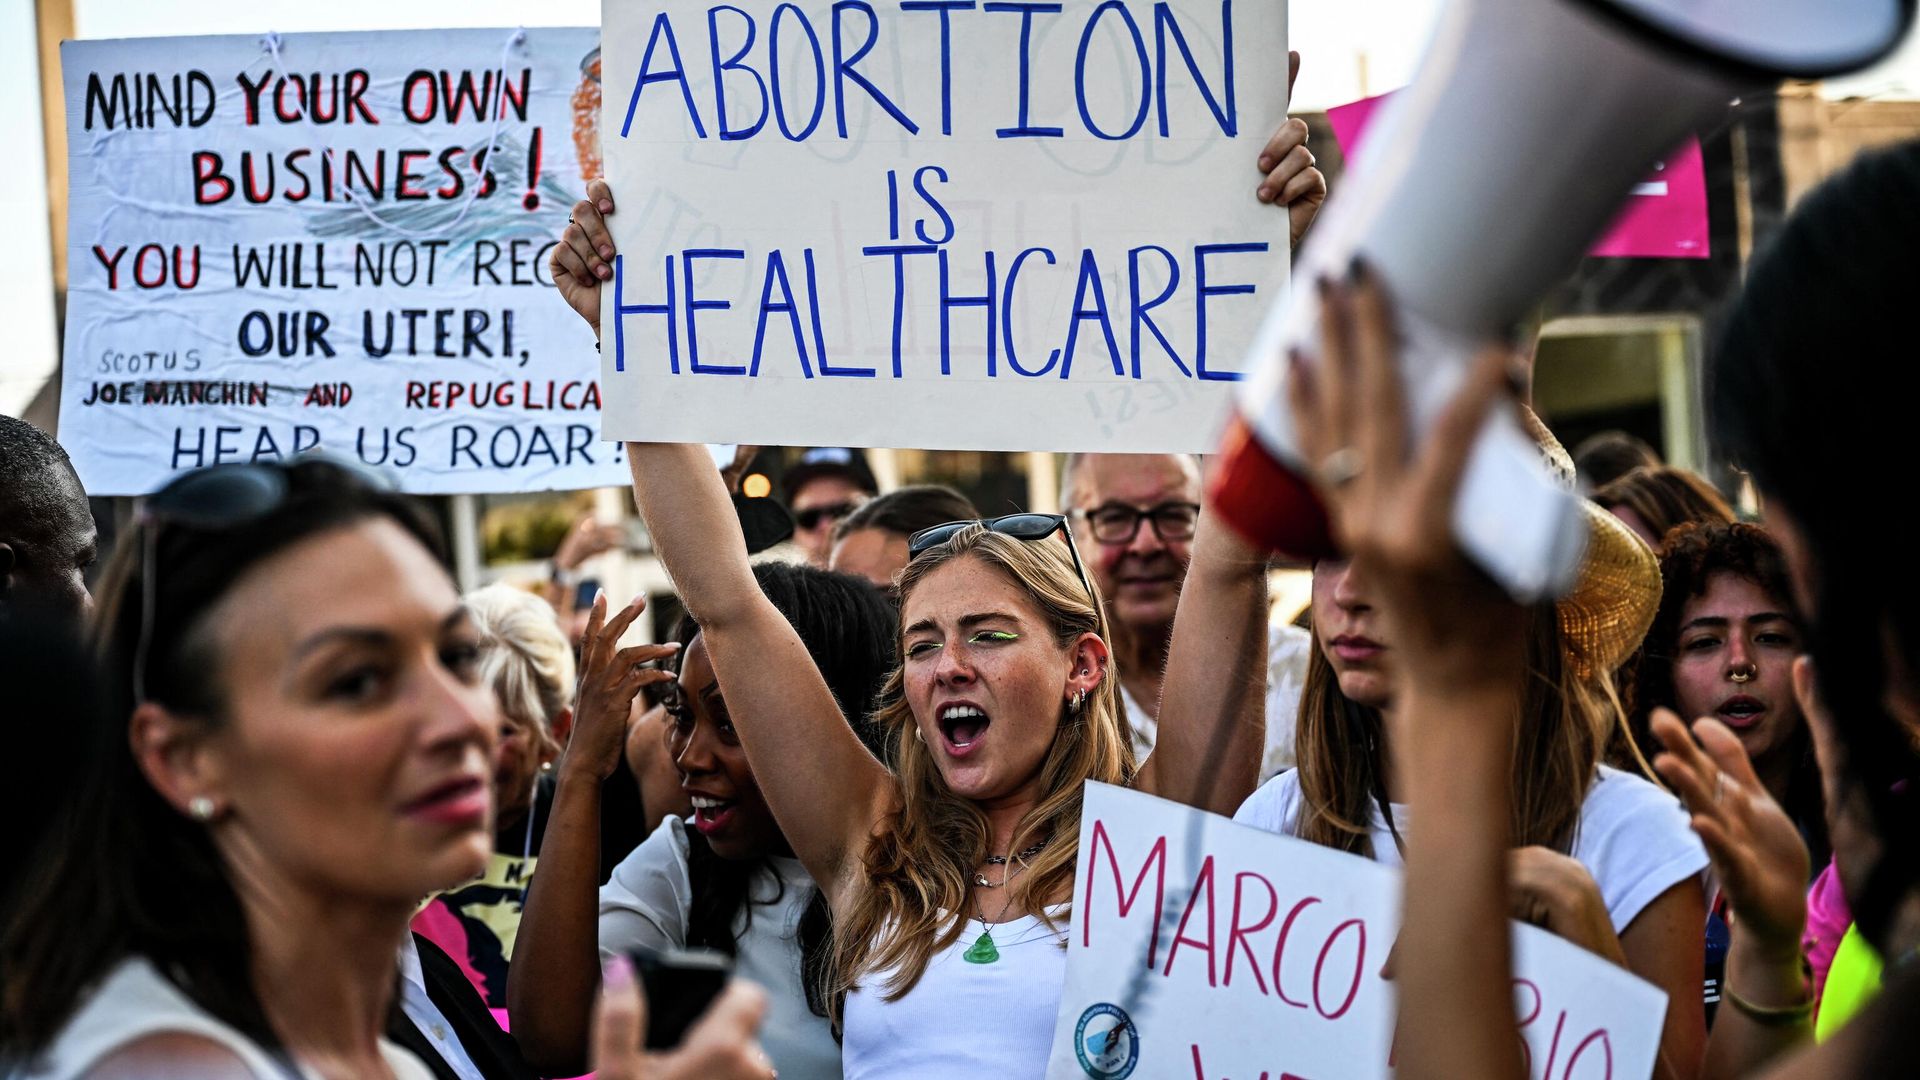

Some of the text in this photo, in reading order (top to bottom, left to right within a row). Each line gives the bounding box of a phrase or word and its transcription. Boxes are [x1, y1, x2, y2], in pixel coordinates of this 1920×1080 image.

[84, 69, 531, 130] MIND YOUR OWN
[621, 0, 1237, 141] ABORTION
[192, 127, 542, 210] BUSINESS!
[888, 165, 955, 244] IS
[92, 244, 201, 290] YOU
[233, 243, 337, 289] WILL
[355, 240, 449, 287] NOT
[238, 309, 530, 368] OUR UTERI,
[615, 242, 1269, 381] HEALTHCARE
[98, 349, 201, 374] SCOTUS
[83, 381, 136, 407] JOE
[143, 380, 269, 407] MANCHIN
[304, 381, 353, 407] AND
[357, 426, 416, 468] US
[1083, 819, 1367, 1020] MARCO
